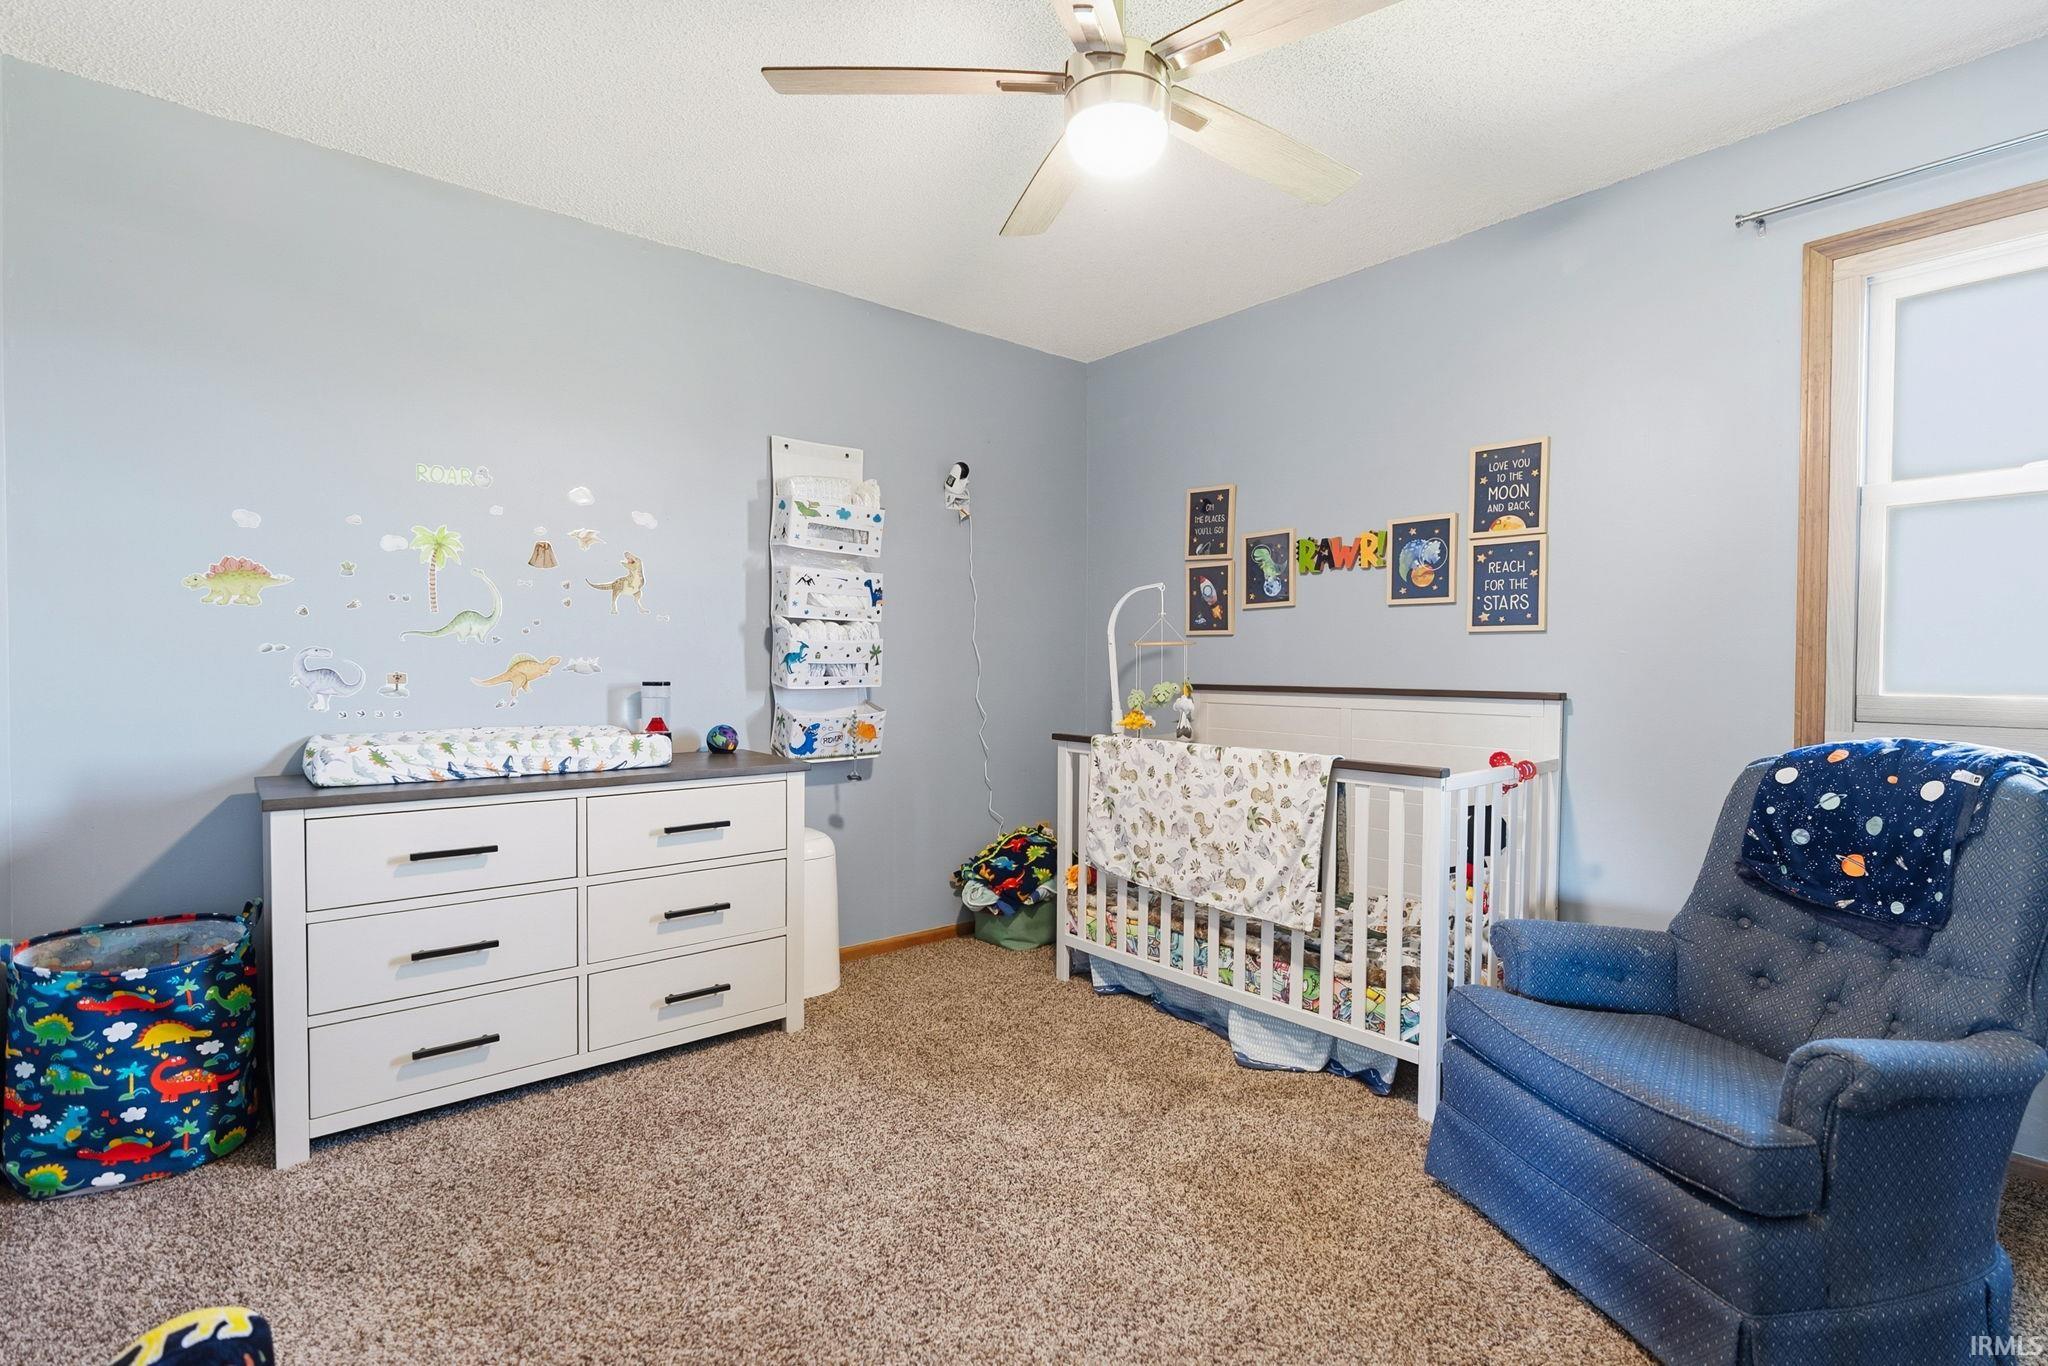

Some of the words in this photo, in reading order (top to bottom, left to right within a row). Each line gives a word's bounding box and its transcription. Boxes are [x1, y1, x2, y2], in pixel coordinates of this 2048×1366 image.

[1488, 460, 1509, 473] LOVE
[1512, 458, 1531, 469] YOU
[416, 464, 473, 486] ROAR
[1496, 473, 1506, 483] TO
[1509, 471, 1524, 481] THE
[1488, 483, 1530, 501] MOON
[1487, 503, 1505, 513] AND
[1507, 501, 1531, 512] BACK
[1194, 515, 1204, 524] THE
[1204, 514, 1226, 524] PLACES
[1296, 530, 1387, 574] RAWR!
[1488, 560, 1526, 574] REACH
[1484, 579, 1505, 591] FOR
[1508, 577, 1529, 590] THE
[1483, 593, 1530, 611] STARS
